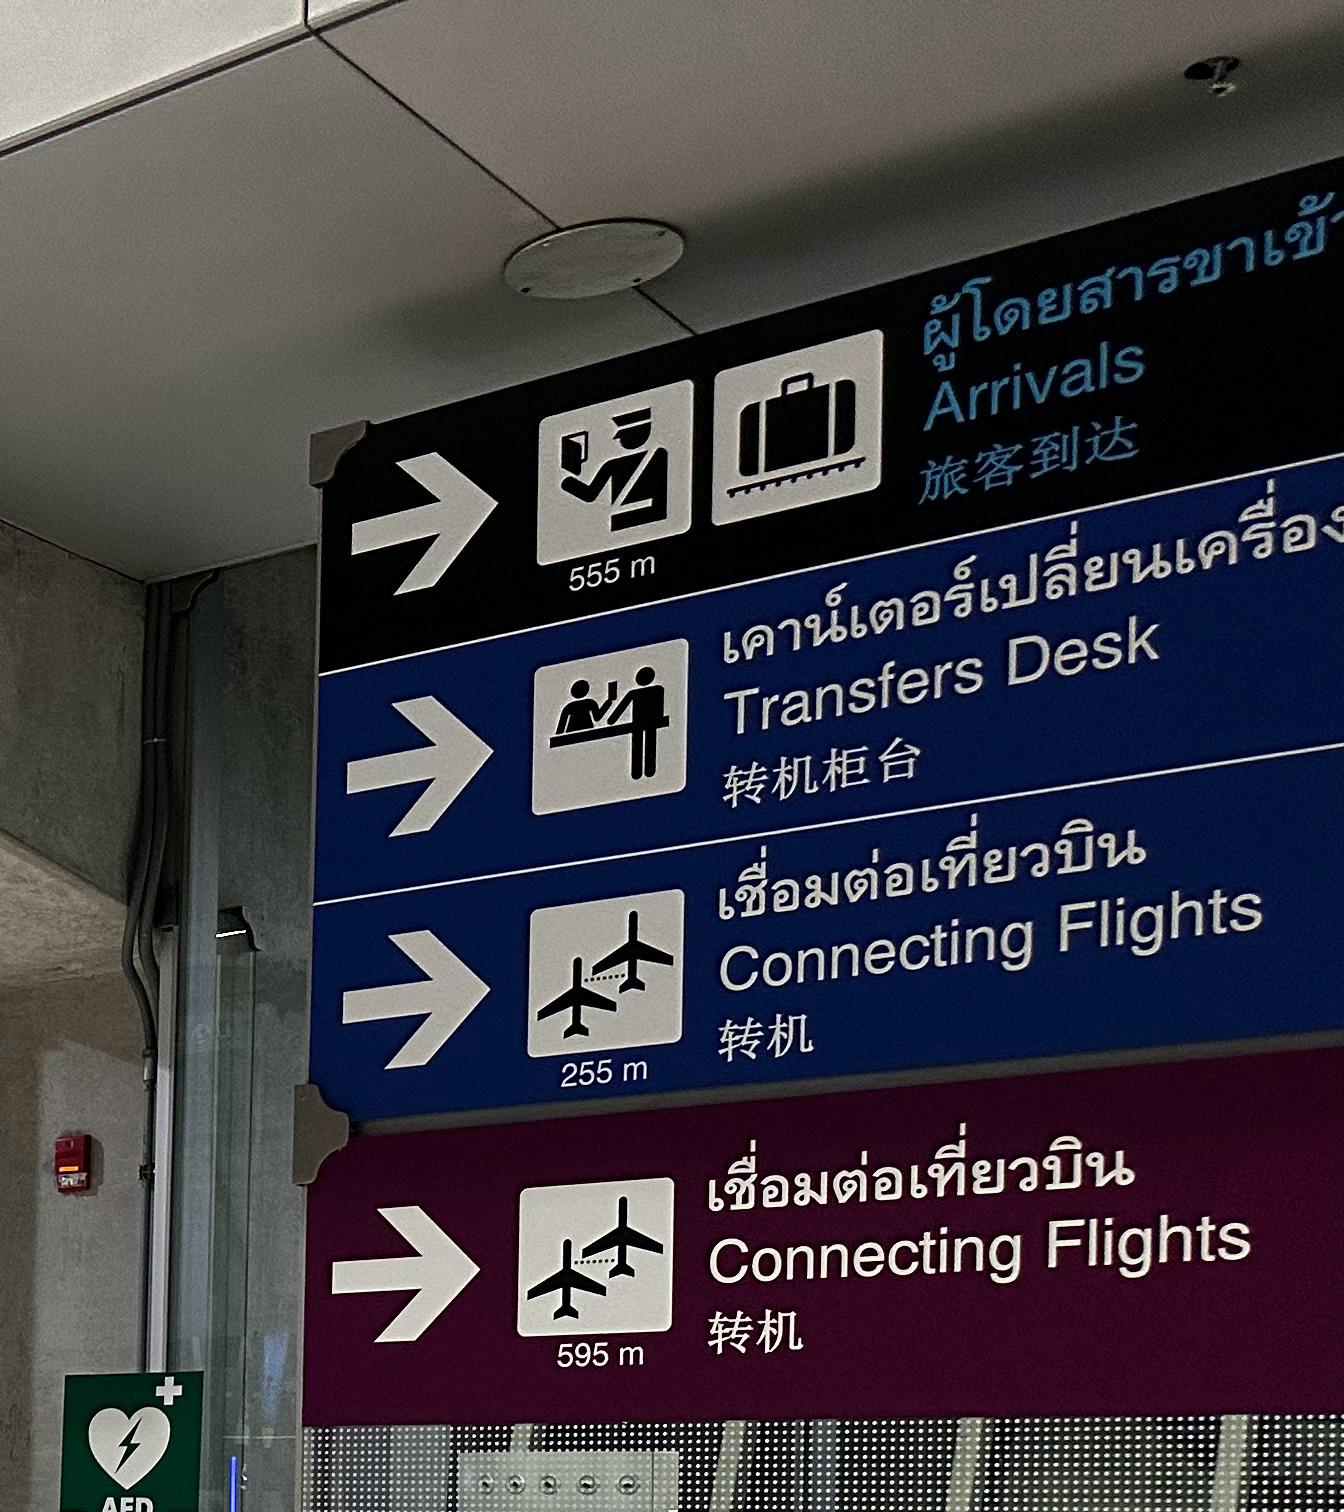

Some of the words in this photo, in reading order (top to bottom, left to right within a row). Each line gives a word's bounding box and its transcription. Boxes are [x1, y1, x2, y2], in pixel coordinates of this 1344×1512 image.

[923, 341, 1147, 432] Arrivals
[918, 416, 1140, 505] 旅客到达
[569, 558, 620, 591] 555
[631, 555, 656, 578] m
[723, 656, 984, 735] Transfers
[1007, 615, 1161, 687] Desk
[722, 737, 922, 809] 转机柜台
[718, 815, 1147, 921] เชื่อมต่อเที่ยวบิน
[719, 914, 1035, 992] Connecting
[1058, 886, 1264, 957] Flights
[560, 1061, 614, 1089] 255
[621, 1057, 649, 1081] m
[718, 1012, 815, 1063] 转机
[708, 1123, 1136, 1212] เชื่อมต่อเที่ยวบิน
[708, 1226, 1022, 1286] Connecting
[1046, 1213, 1252, 1279] Flights
[556, 1342, 611, 1369] 595
[618, 1343, 645, 1367] m
[708, 1309, 804, 1356] 转机
